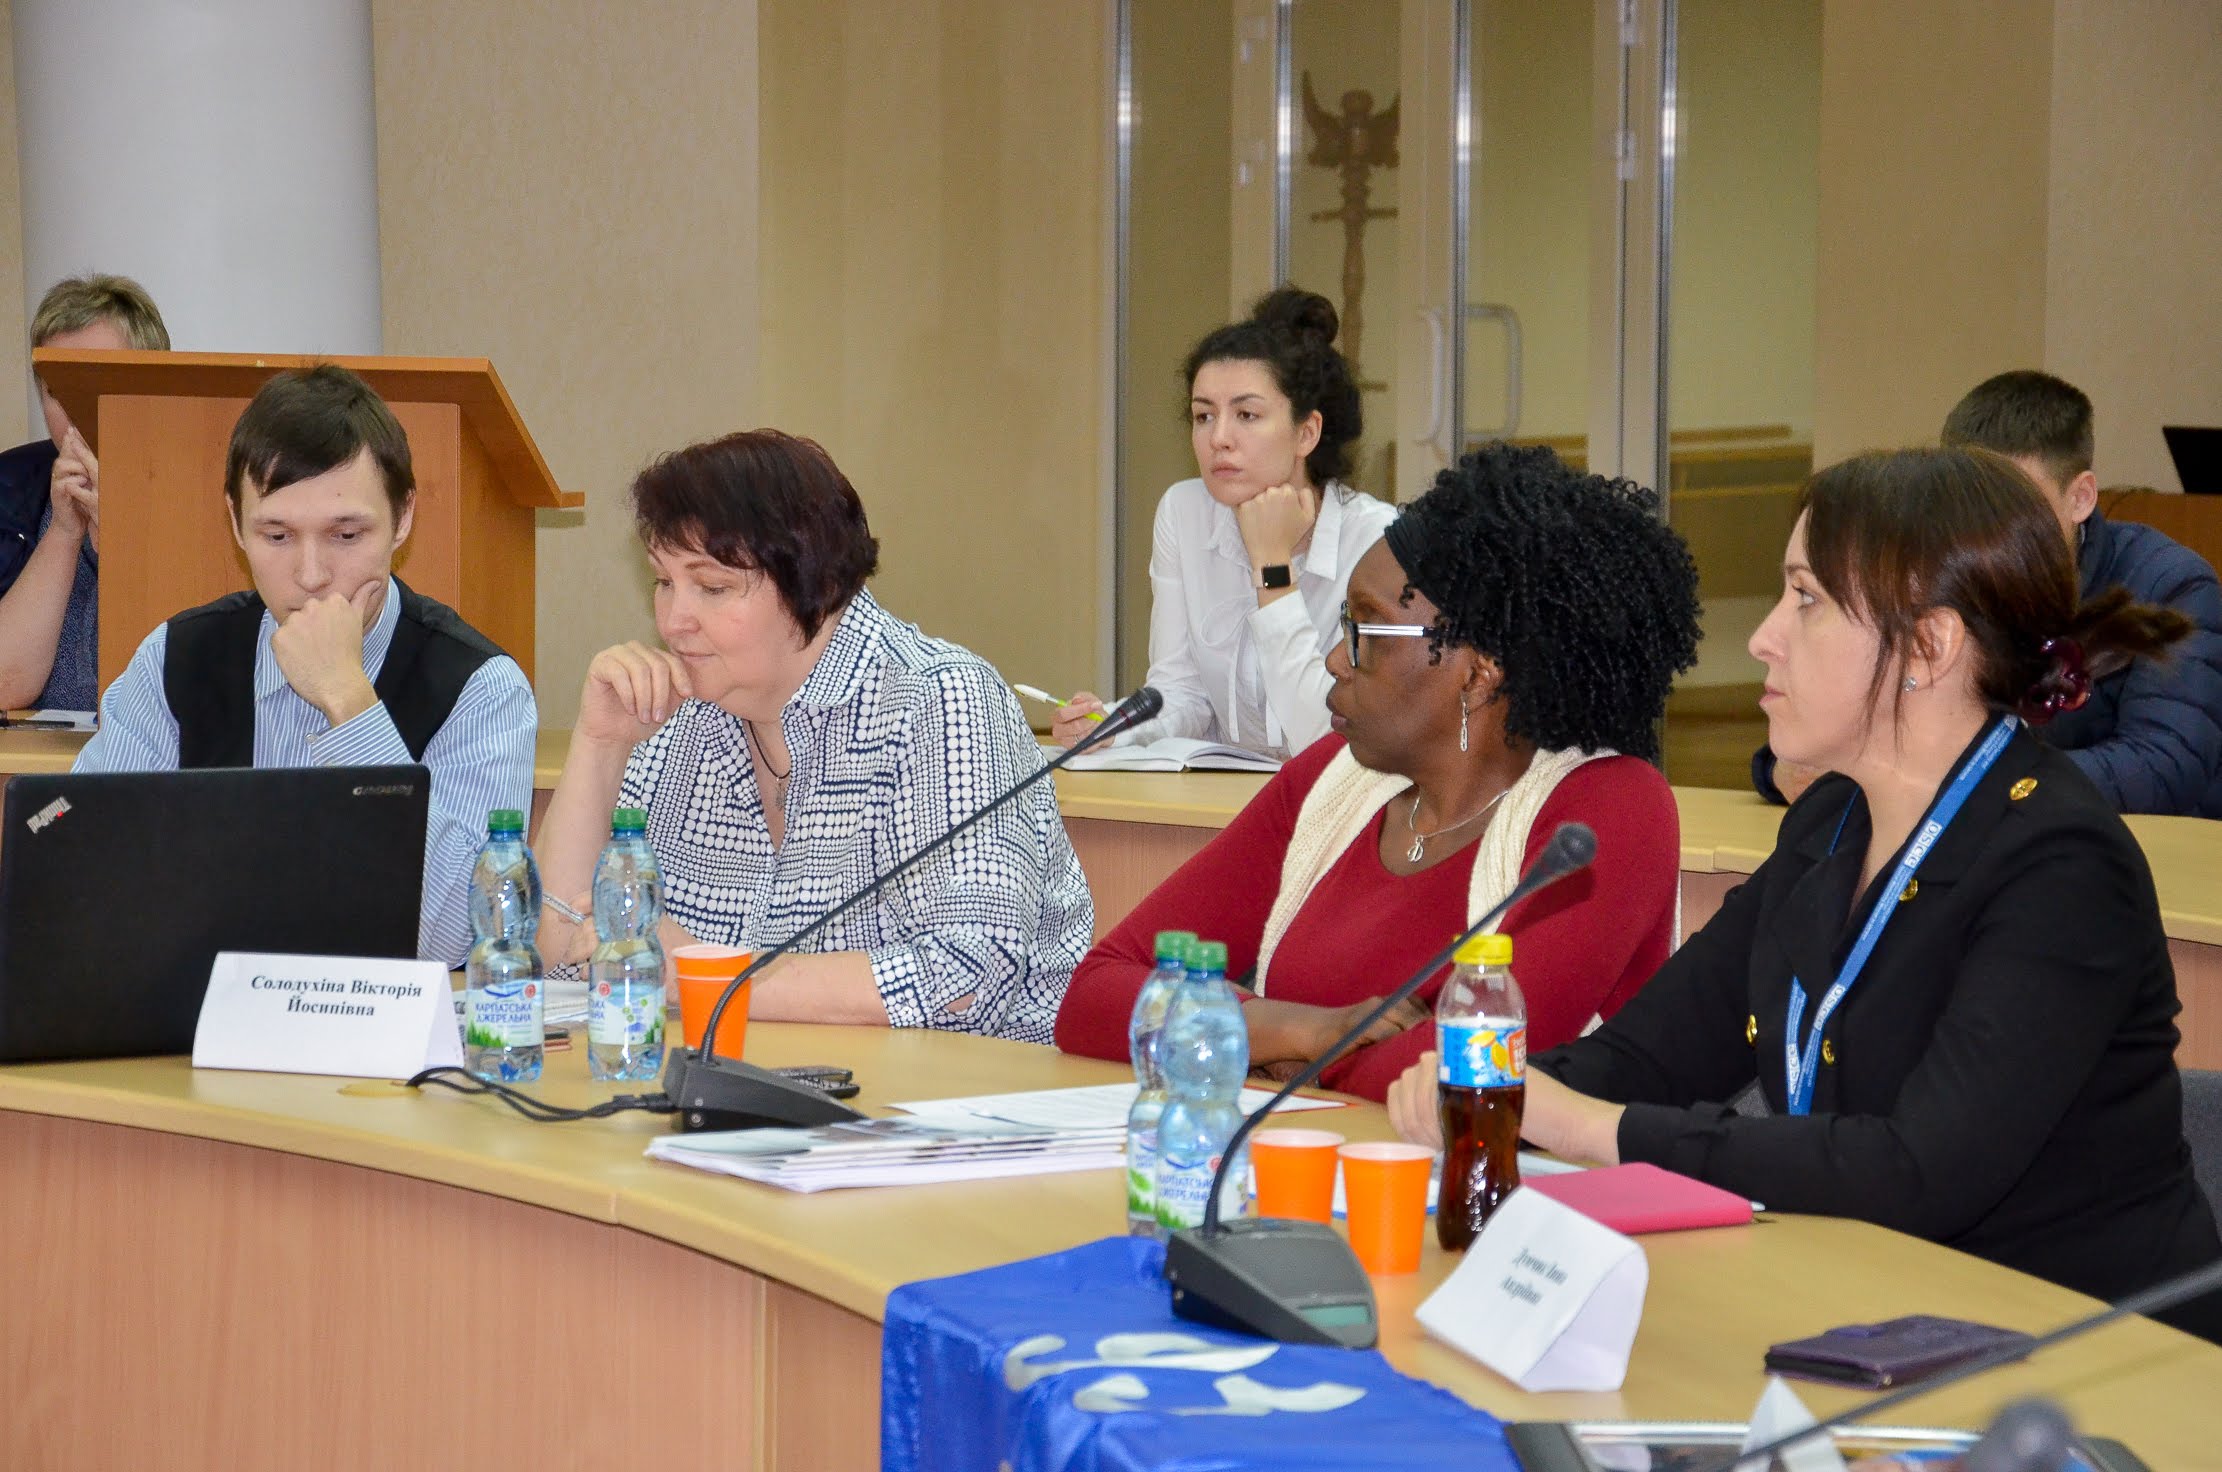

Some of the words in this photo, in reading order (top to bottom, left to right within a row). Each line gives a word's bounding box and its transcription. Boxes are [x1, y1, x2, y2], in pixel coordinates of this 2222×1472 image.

[251, 975, 345, 994] Солодухіна
[350, 979, 422, 999] Вікторія
[287, 995, 375, 1016] Йосипівна
